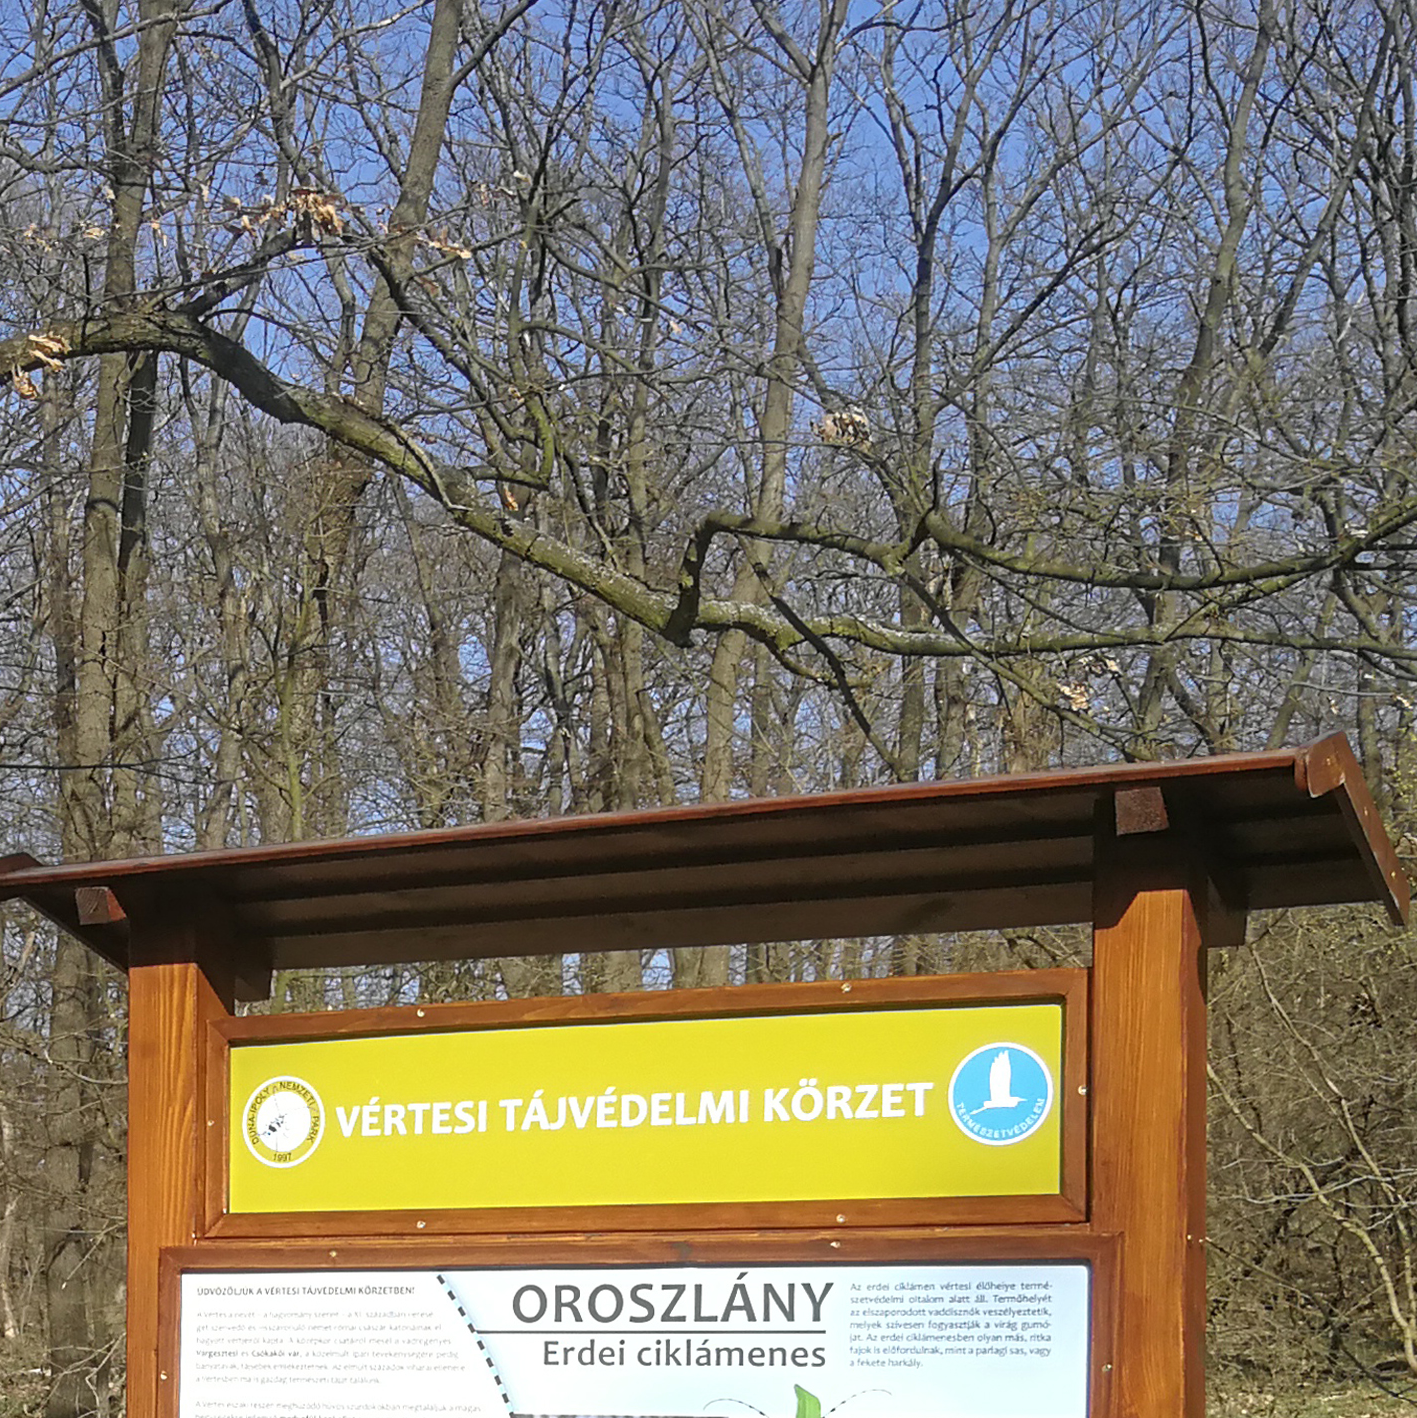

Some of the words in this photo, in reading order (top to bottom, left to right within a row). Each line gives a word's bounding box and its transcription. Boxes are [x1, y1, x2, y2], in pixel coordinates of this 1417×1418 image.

[279, 1081, 316, 1107] NEMZETI
[306, 1115, 320, 1144] PARK
[335, 1096, 487, 1137] VÉRTESI
[498, 1086, 749, 1131] TÁJVÉDELMI
[763, 1077, 934, 1122] KÖRZET
[956, 1097, 1046, 1139] TERMÉSZETVÉDELEM
[196, 1287, 254, 1296] ÜDVÖZÖLJÜK
[256, 1287, 262, 1296] A
[264, 1286, 299, 1296] VÉRTESI
[302, 1286, 356, 1295] TÁJVÉDELMI
[357, 1286, 414, 1295] KÖRZETBEN!
[512, 1271, 834, 1323] OROSZLÁNY
[543, 1338, 626, 1366] Erdei
[637, 1338, 826, 1368] ciklámenes
